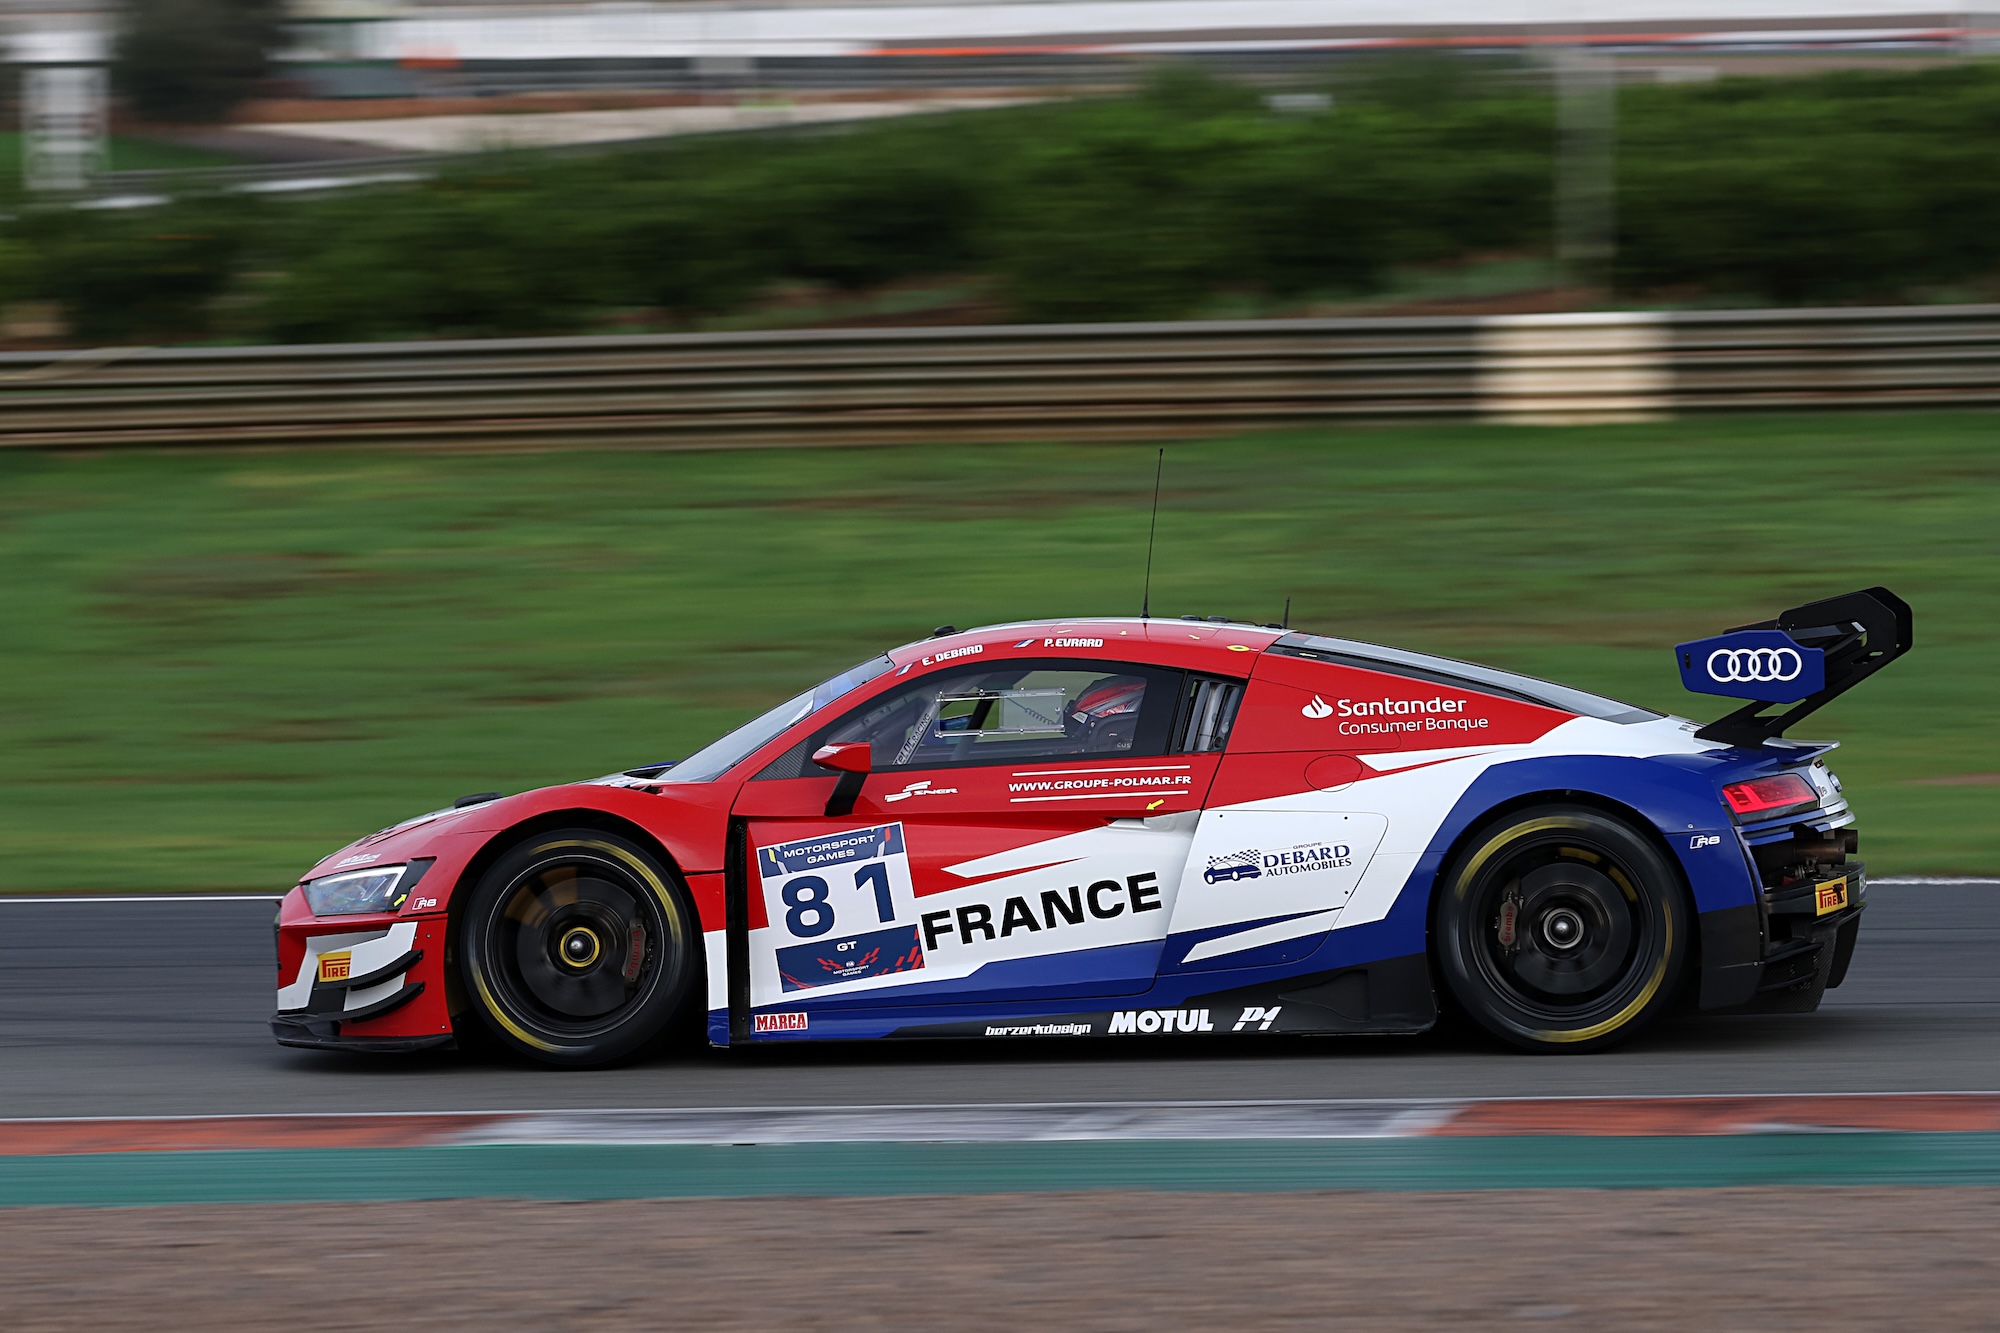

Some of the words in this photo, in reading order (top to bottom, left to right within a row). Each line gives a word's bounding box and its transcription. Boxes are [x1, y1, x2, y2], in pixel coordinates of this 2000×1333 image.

[935, 644, 983, 662] DEBARD
[1337, 697, 1467, 717] Santander
[912, 713, 931, 744] RACING
[1338, 720, 1422, 735] Consumer
[1425, 717, 1489, 731] Banque
[1008, 776, 1192, 792] WWW.GROUPE-POLMAR.FR
[783, 835, 875, 858] MOTORSPORT
[1292, 842, 1322, 850] GROUPE
[806, 849, 856, 864] GAMES
[1263, 845, 1350, 868] DEBARD
[1265, 858, 1352, 877] AUTOMOBILES
[781, 861, 895, 938] 81
[920, 871, 1162, 951] FRANCE
[1503, 905, 1515, 942] brembo
[627, 930, 641, 975] brembo
[836, 941, 857, 951] GT
[833, 965, 870, 975] MOTORSPORT
[755, 1013, 807, 1031] MARCA
[1108, 1009, 1214, 1034] MOTUL
[1231, 1006, 1282, 1031] P1
